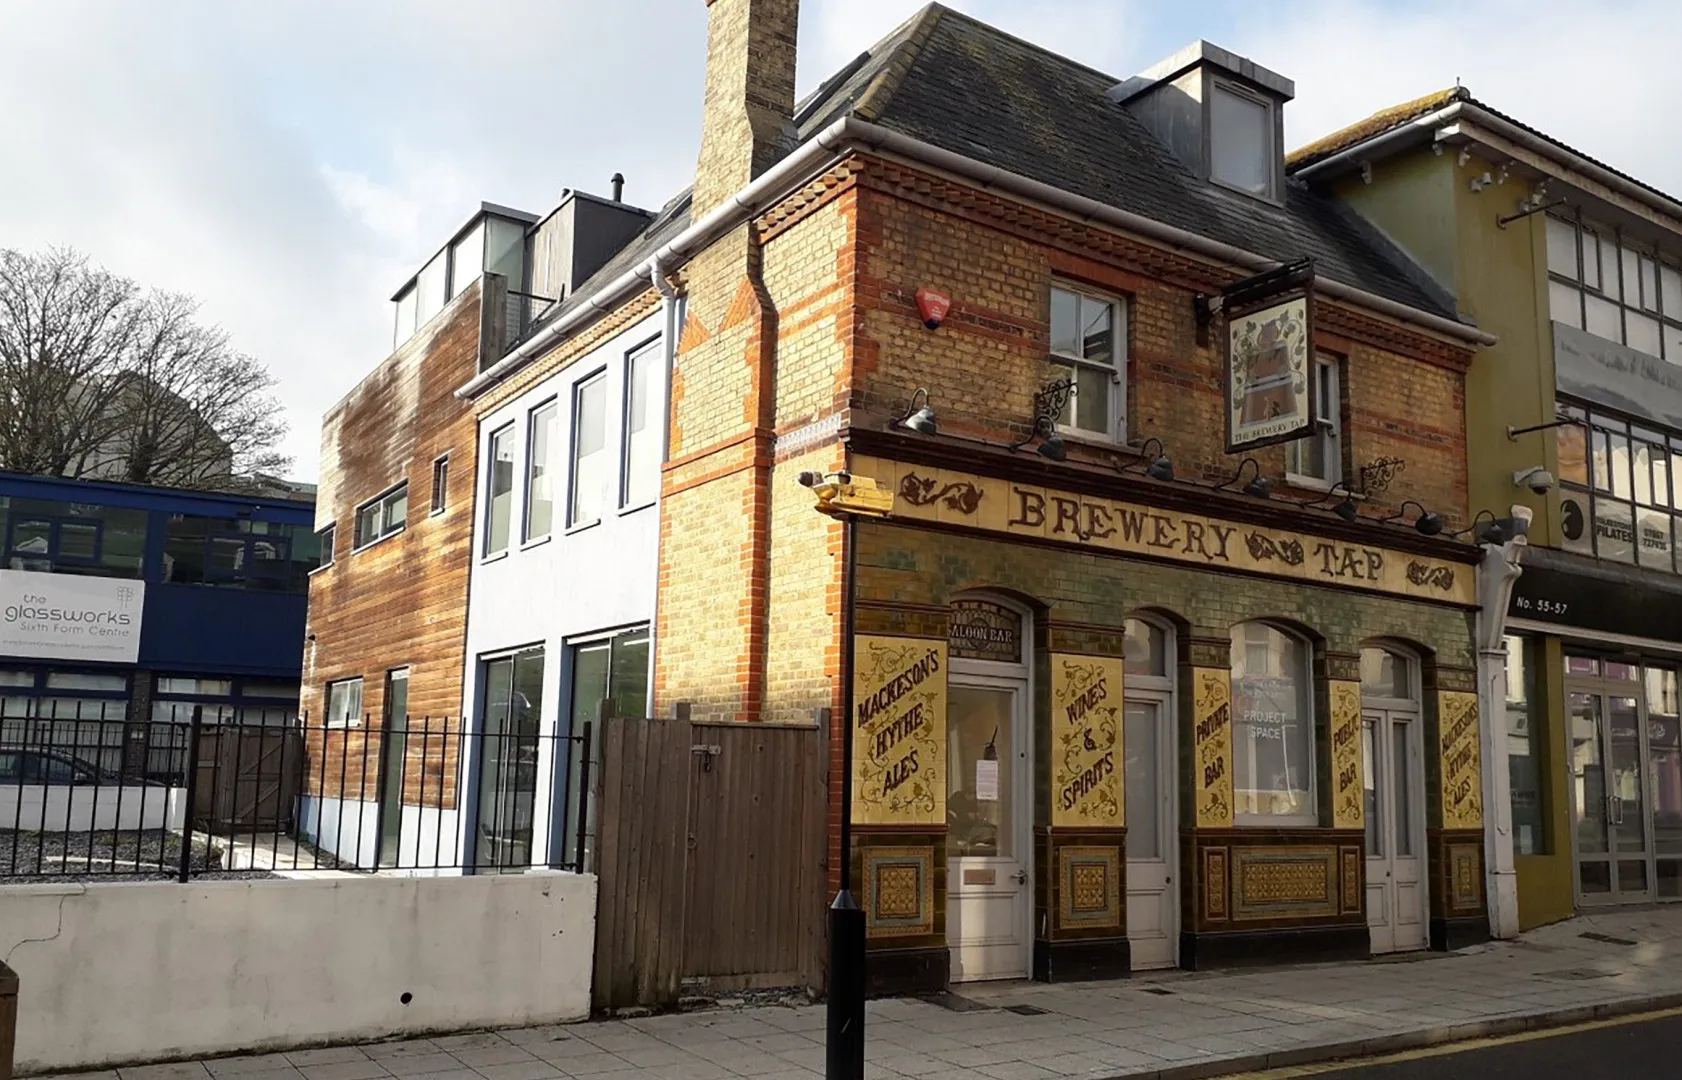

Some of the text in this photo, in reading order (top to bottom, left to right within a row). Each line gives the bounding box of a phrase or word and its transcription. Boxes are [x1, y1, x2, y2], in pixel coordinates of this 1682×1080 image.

[1291, 417, 1305, 429] TAP
[1008, 486, 1384, 581] BREWERY TAP
[1596, 524, 1634, 543] PILATES
[23, 593, 47, 605] the
[1516, 596, 1568, 616] No. 55-57
[4, 604, 131, 625] glassworks
[20, 621, 130, 637] Sixth Form Centre
[990, 628, 1013, 643] BAR
[857, 647, 940, 729] MACKESON'S
[1065, 677, 1108, 725] WINES
[1196, 701, 1230, 746] PRIVATE
[1243, 710, 1287, 725] PROJECT
[875, 702, 924, 759] HYTHE
[1083, 727, 1097, 752] &
[1250, 726, 1281, 740] SPACE
[1063, 751, 1114, 811] SPIRITS
[1204, 755, 1225, 789] BAR
[1340, 762, 1357, 793] BAR
